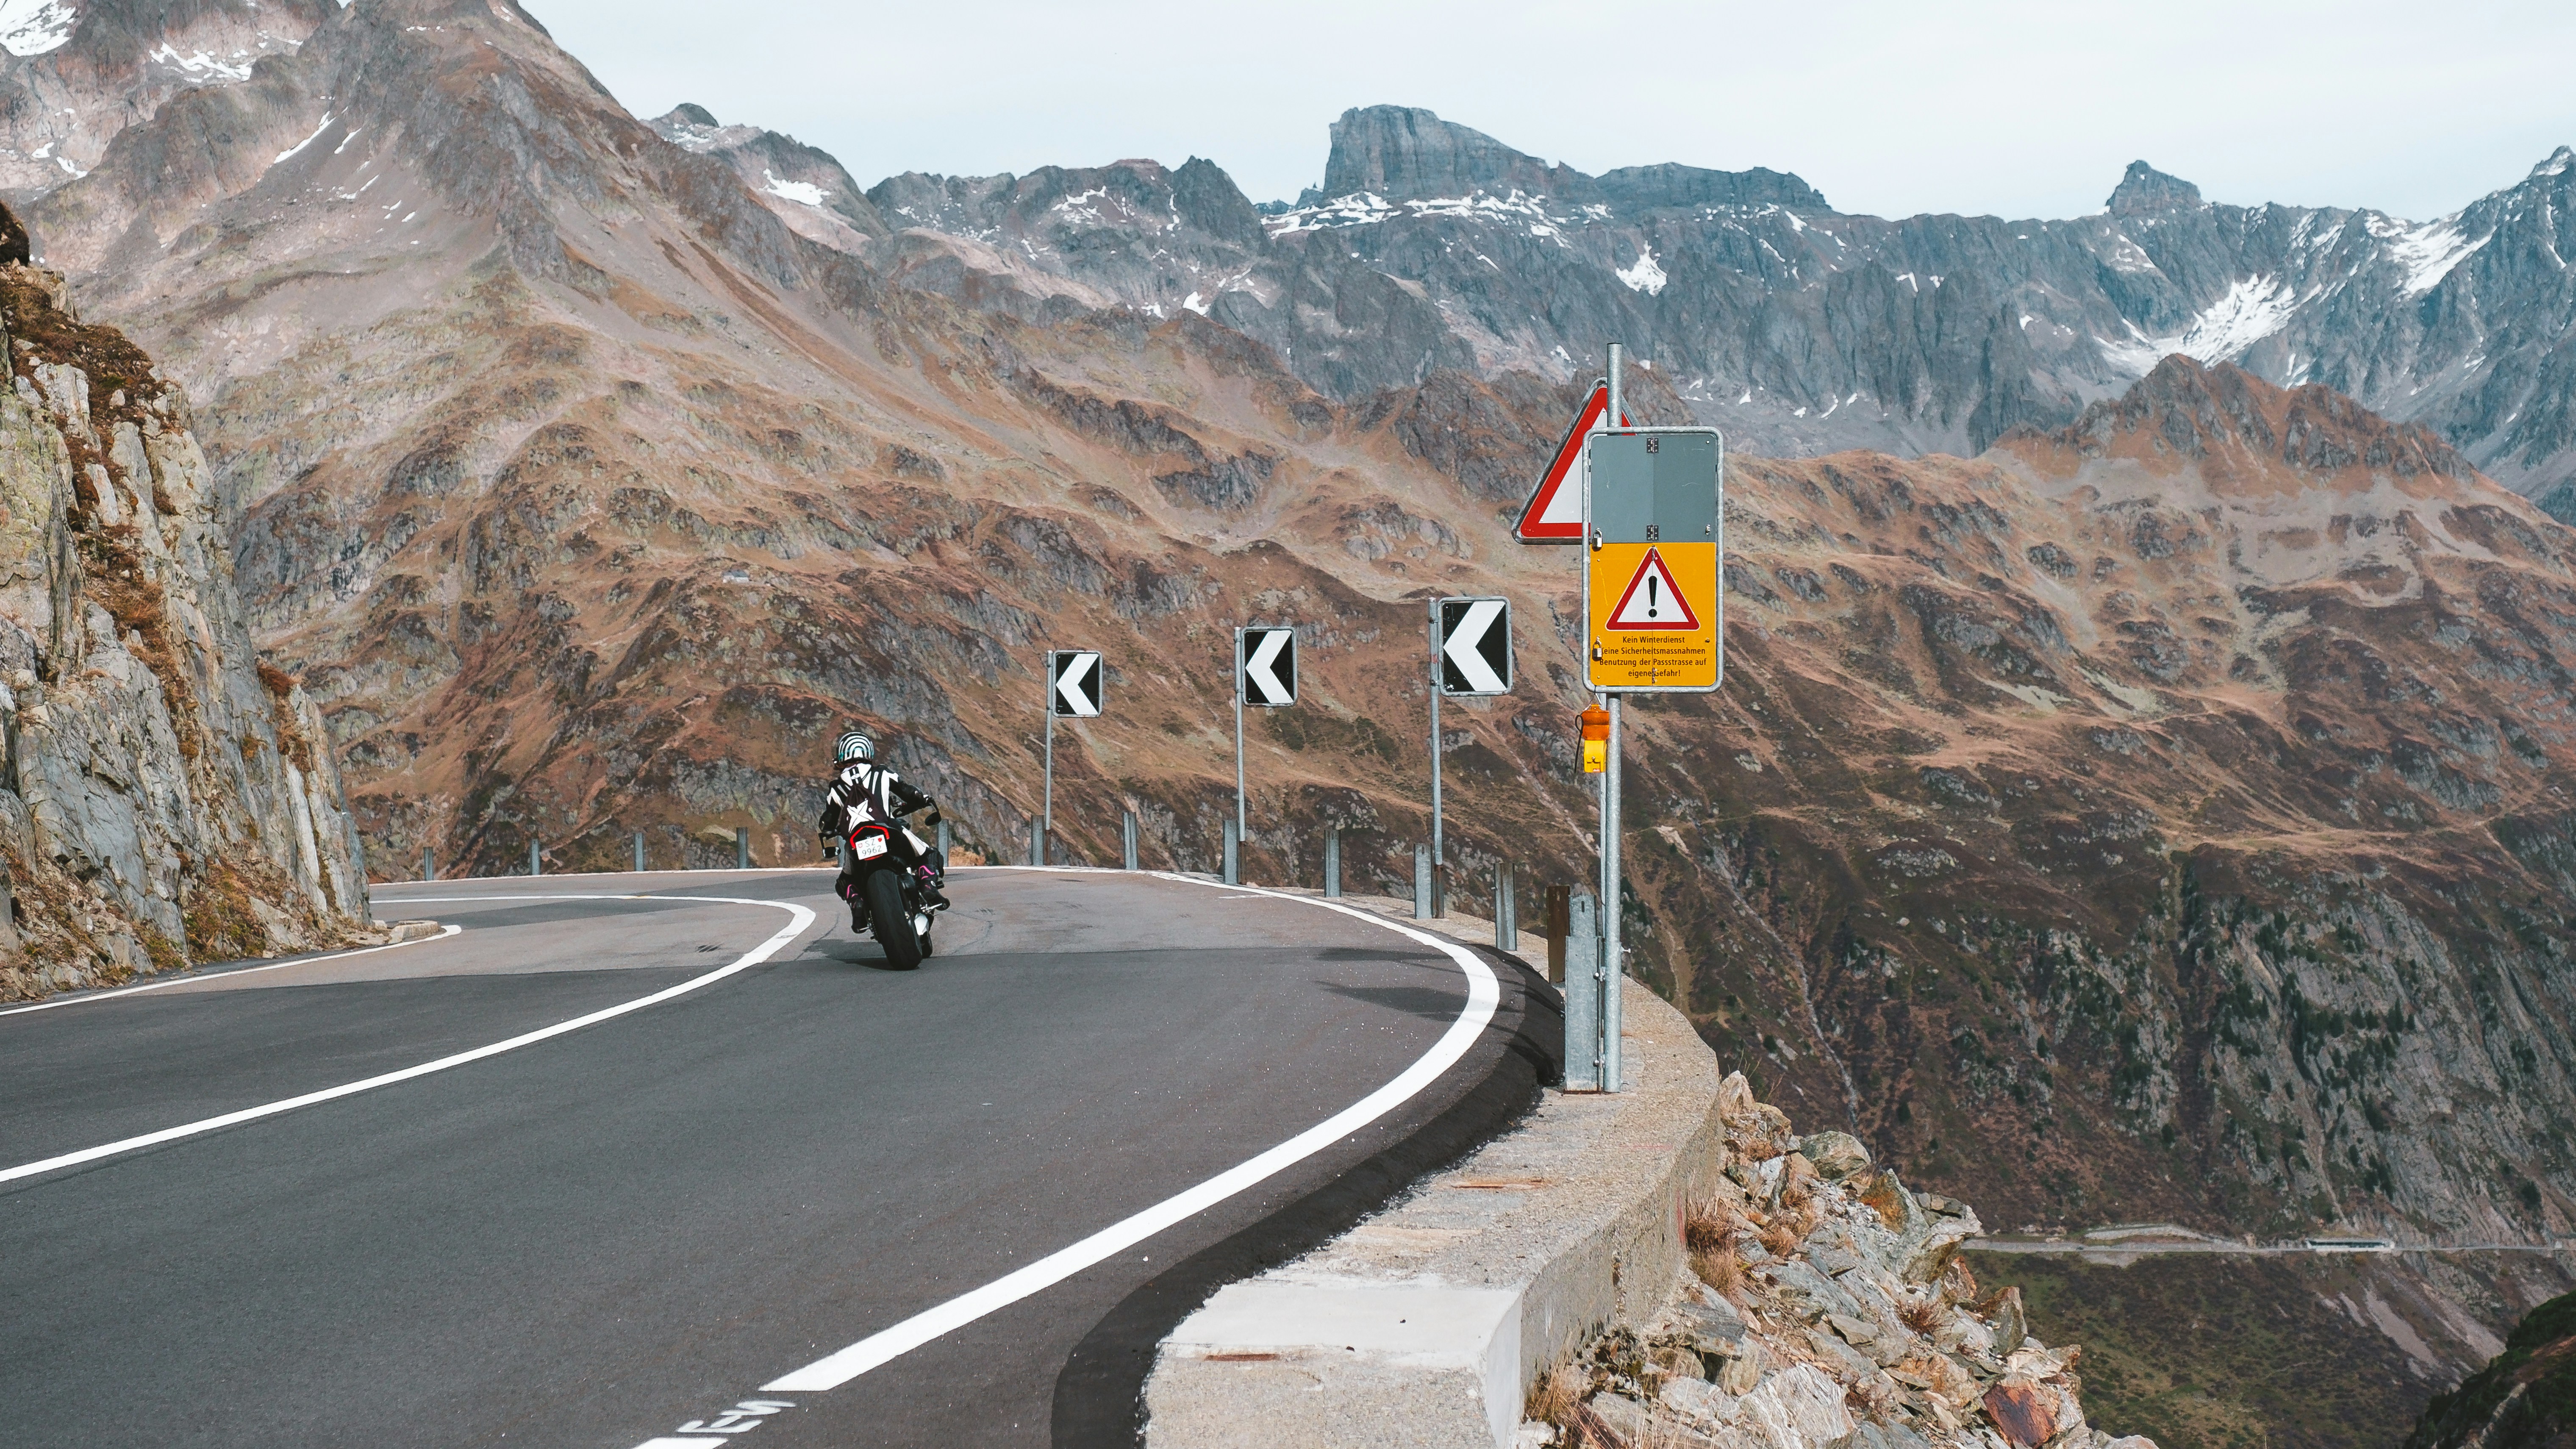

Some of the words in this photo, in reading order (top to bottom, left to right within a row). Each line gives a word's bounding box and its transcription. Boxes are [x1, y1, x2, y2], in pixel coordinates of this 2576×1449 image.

[1599, 659, 1636, 667] Benutzung
[1628, 669, 1652, 678] eigene
[865, 838, 875, 847] SZ
[862, 845, 882, 857] 9962
